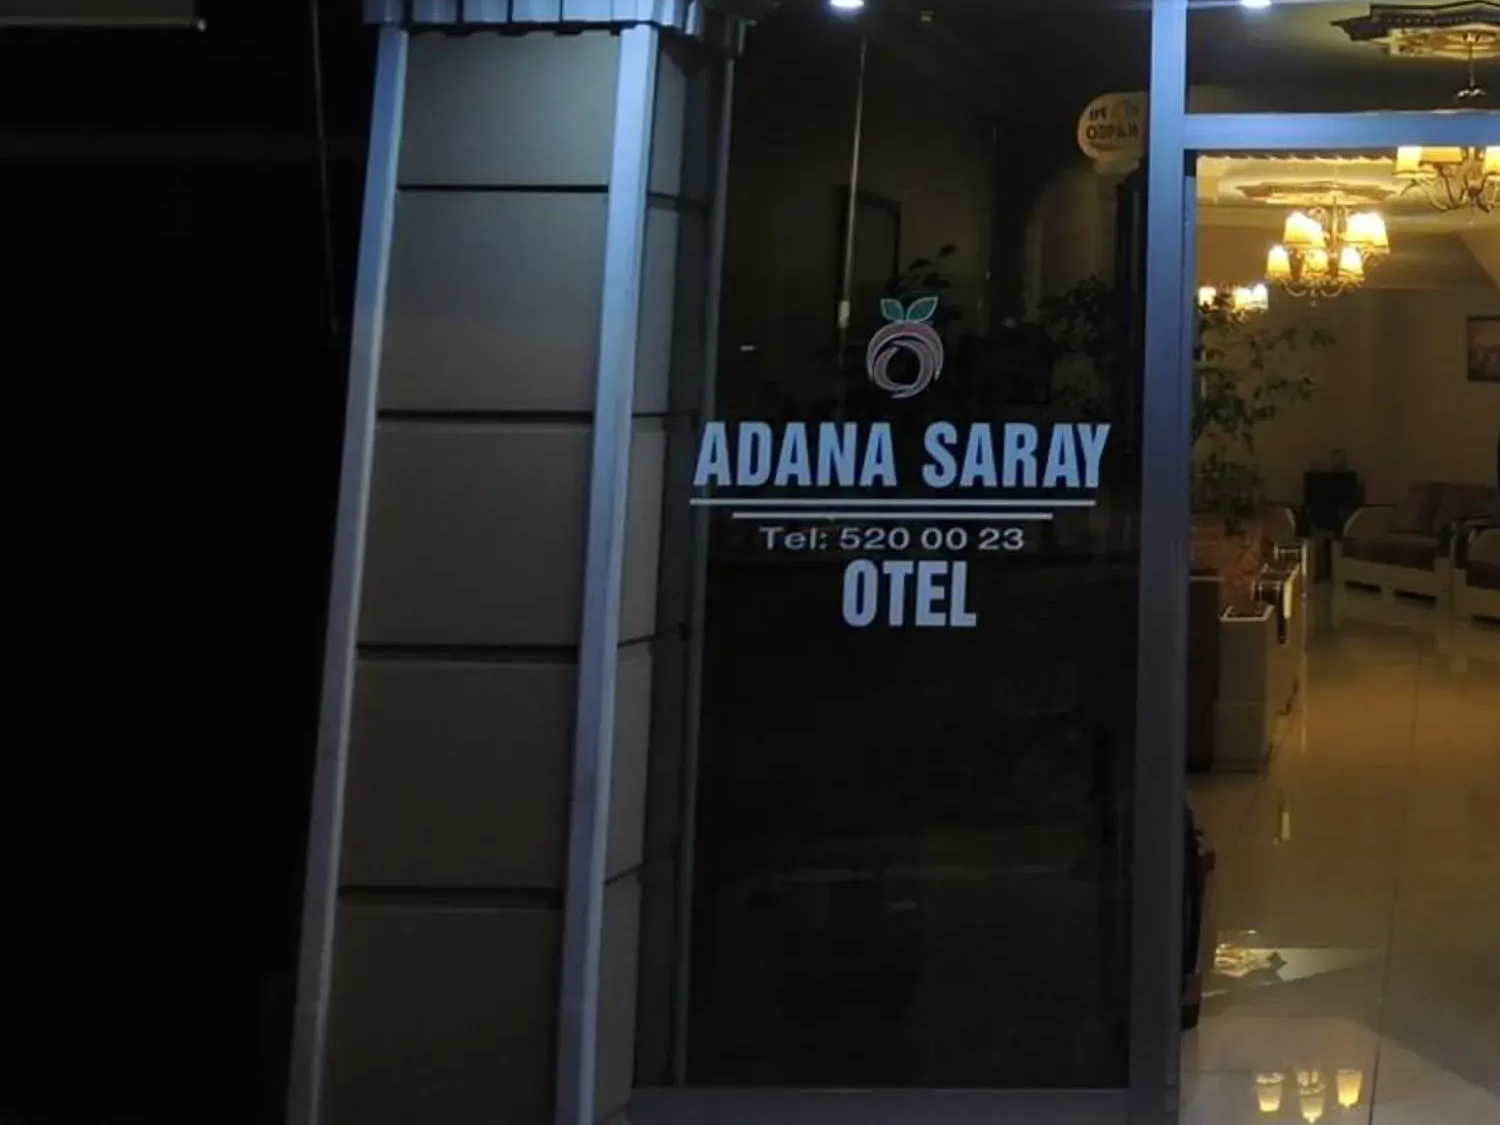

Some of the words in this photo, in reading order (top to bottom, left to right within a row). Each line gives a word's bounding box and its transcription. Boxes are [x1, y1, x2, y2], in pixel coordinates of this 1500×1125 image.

[693, 421, 898, 487] ADANA
[921, 421, 1110, 488] SARAY
[758, 526, 828, 550] Tel:
[839, 526, 910, 550] 520
[920, 526, 968, 550] 00
[978, 527, 1025, 550] 23
[841, 558, 977, 627] OTEL
